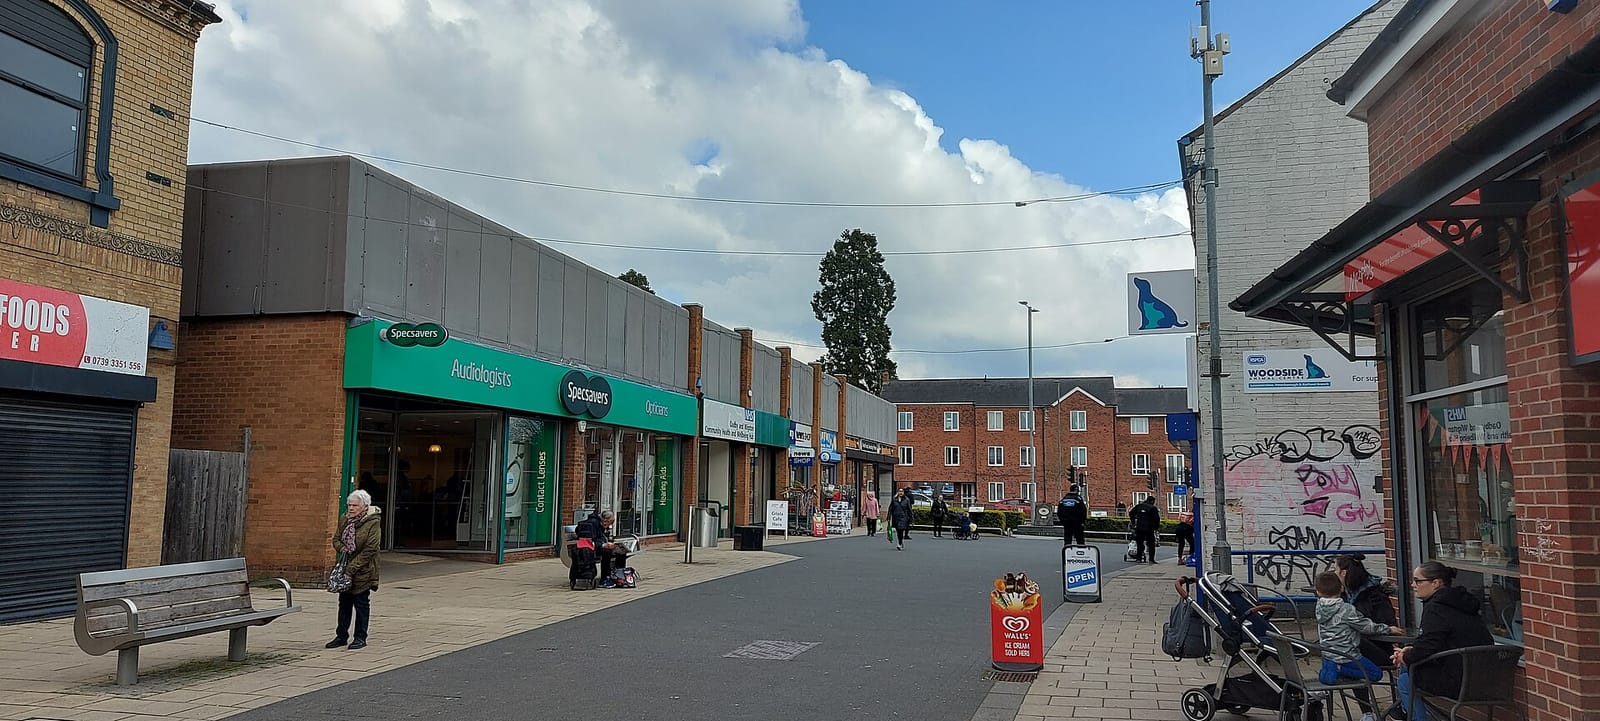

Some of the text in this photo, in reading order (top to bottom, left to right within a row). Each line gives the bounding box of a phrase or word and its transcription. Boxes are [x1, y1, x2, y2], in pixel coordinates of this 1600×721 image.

[391, 328, 438, 339] Specsavers
[92, 356, 141, 371] 0739 3351 556
[451, 358, 512, 388] Audiologists
[1248, 368, 1304, 377] WOODSIDE
[567, 381, 609, 405] Specsavers
[645, 399, 669, 417] Opticians
[535, 451, 546, 514] Contact Lenses
[659, 466, 668, 506] Hearing Aids
[1068, 571, 1095, 584] OPEN
[1004, 632, 1029, 640] WALL'S
[1005, 649, 1030, 657] SOLD HERE
[1013, 642, 1030, 650] CREAM
